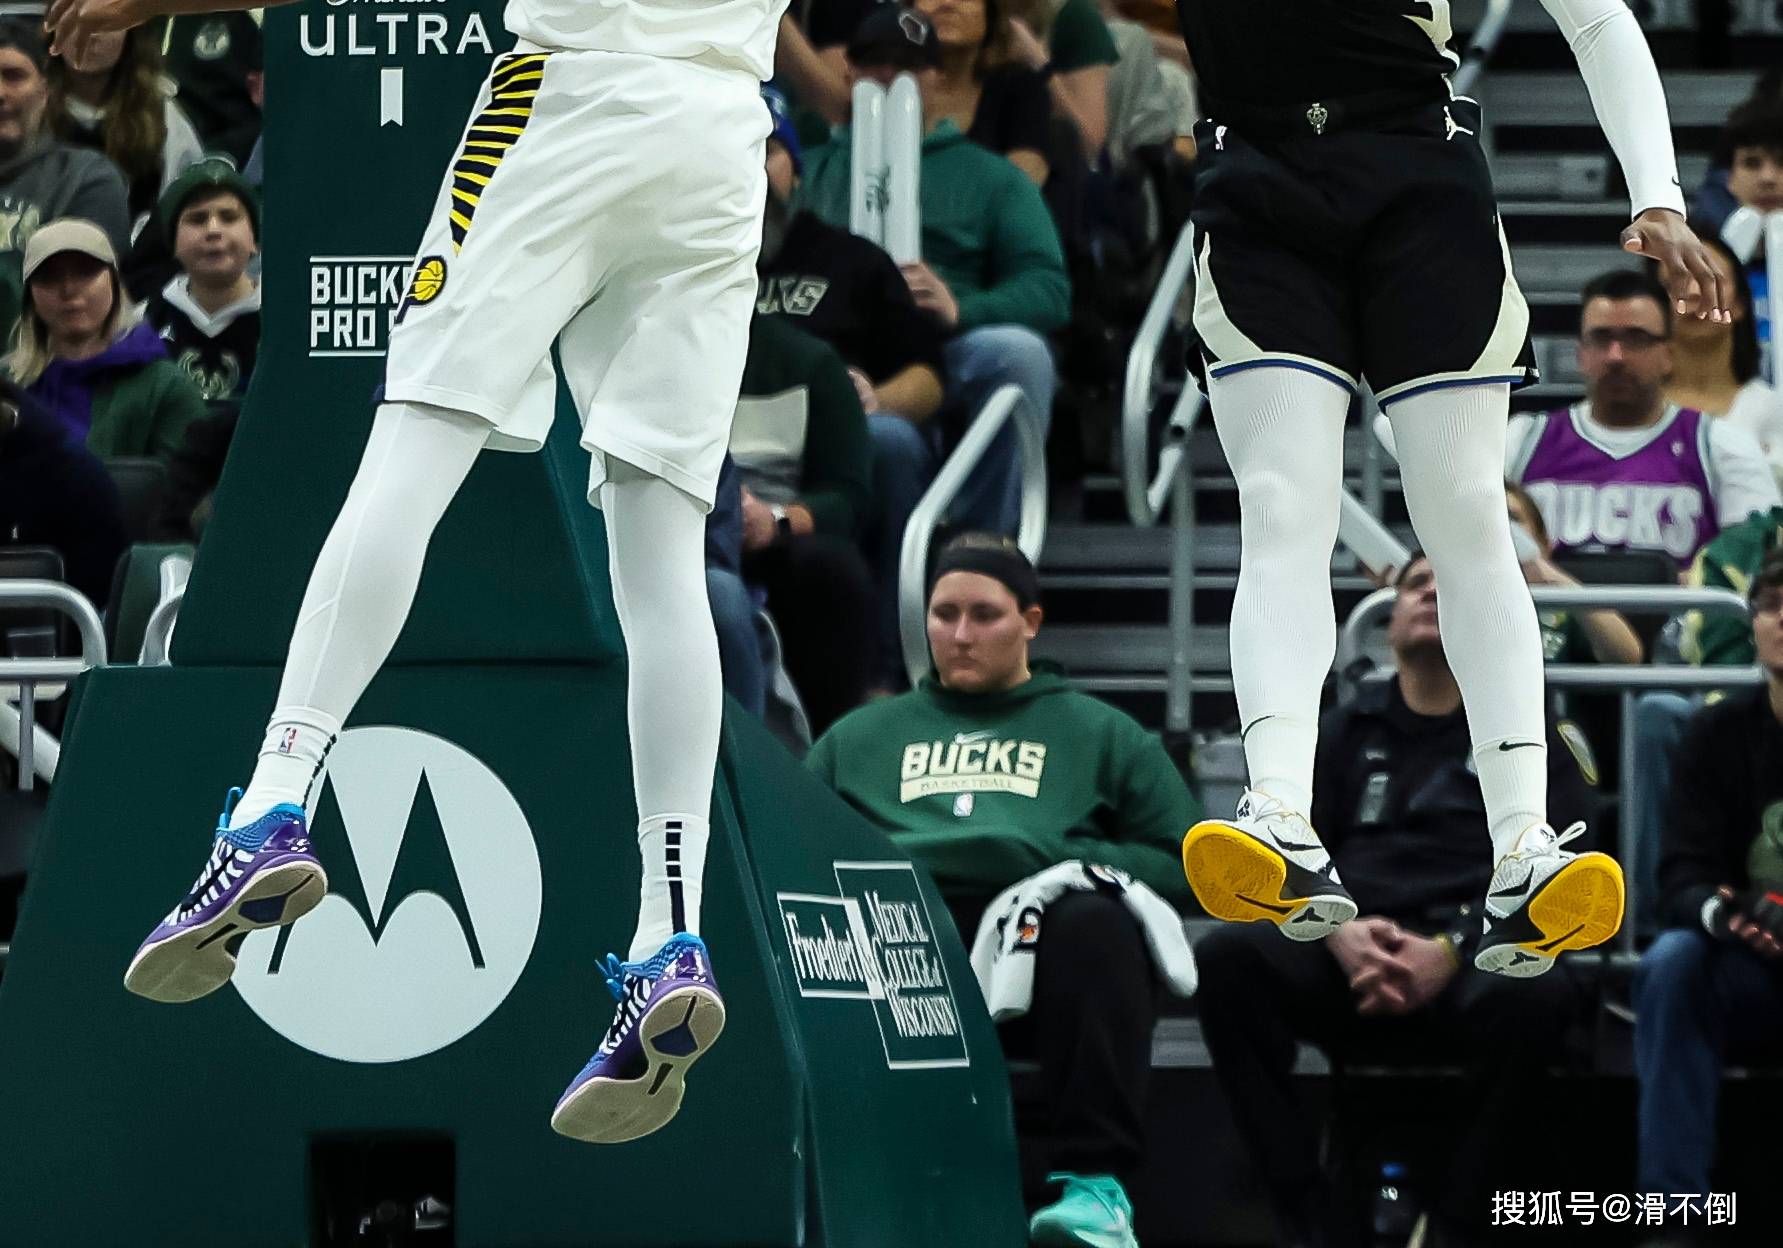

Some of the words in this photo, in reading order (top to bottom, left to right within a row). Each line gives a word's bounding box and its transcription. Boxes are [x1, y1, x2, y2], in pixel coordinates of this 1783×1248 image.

[299, 12, 494, 56] ULTRA
[310, 308, 376, 347] PRO
[901, 740, 1047, 781] BUCKS
[785, 912, 864, 983] Froedtert
